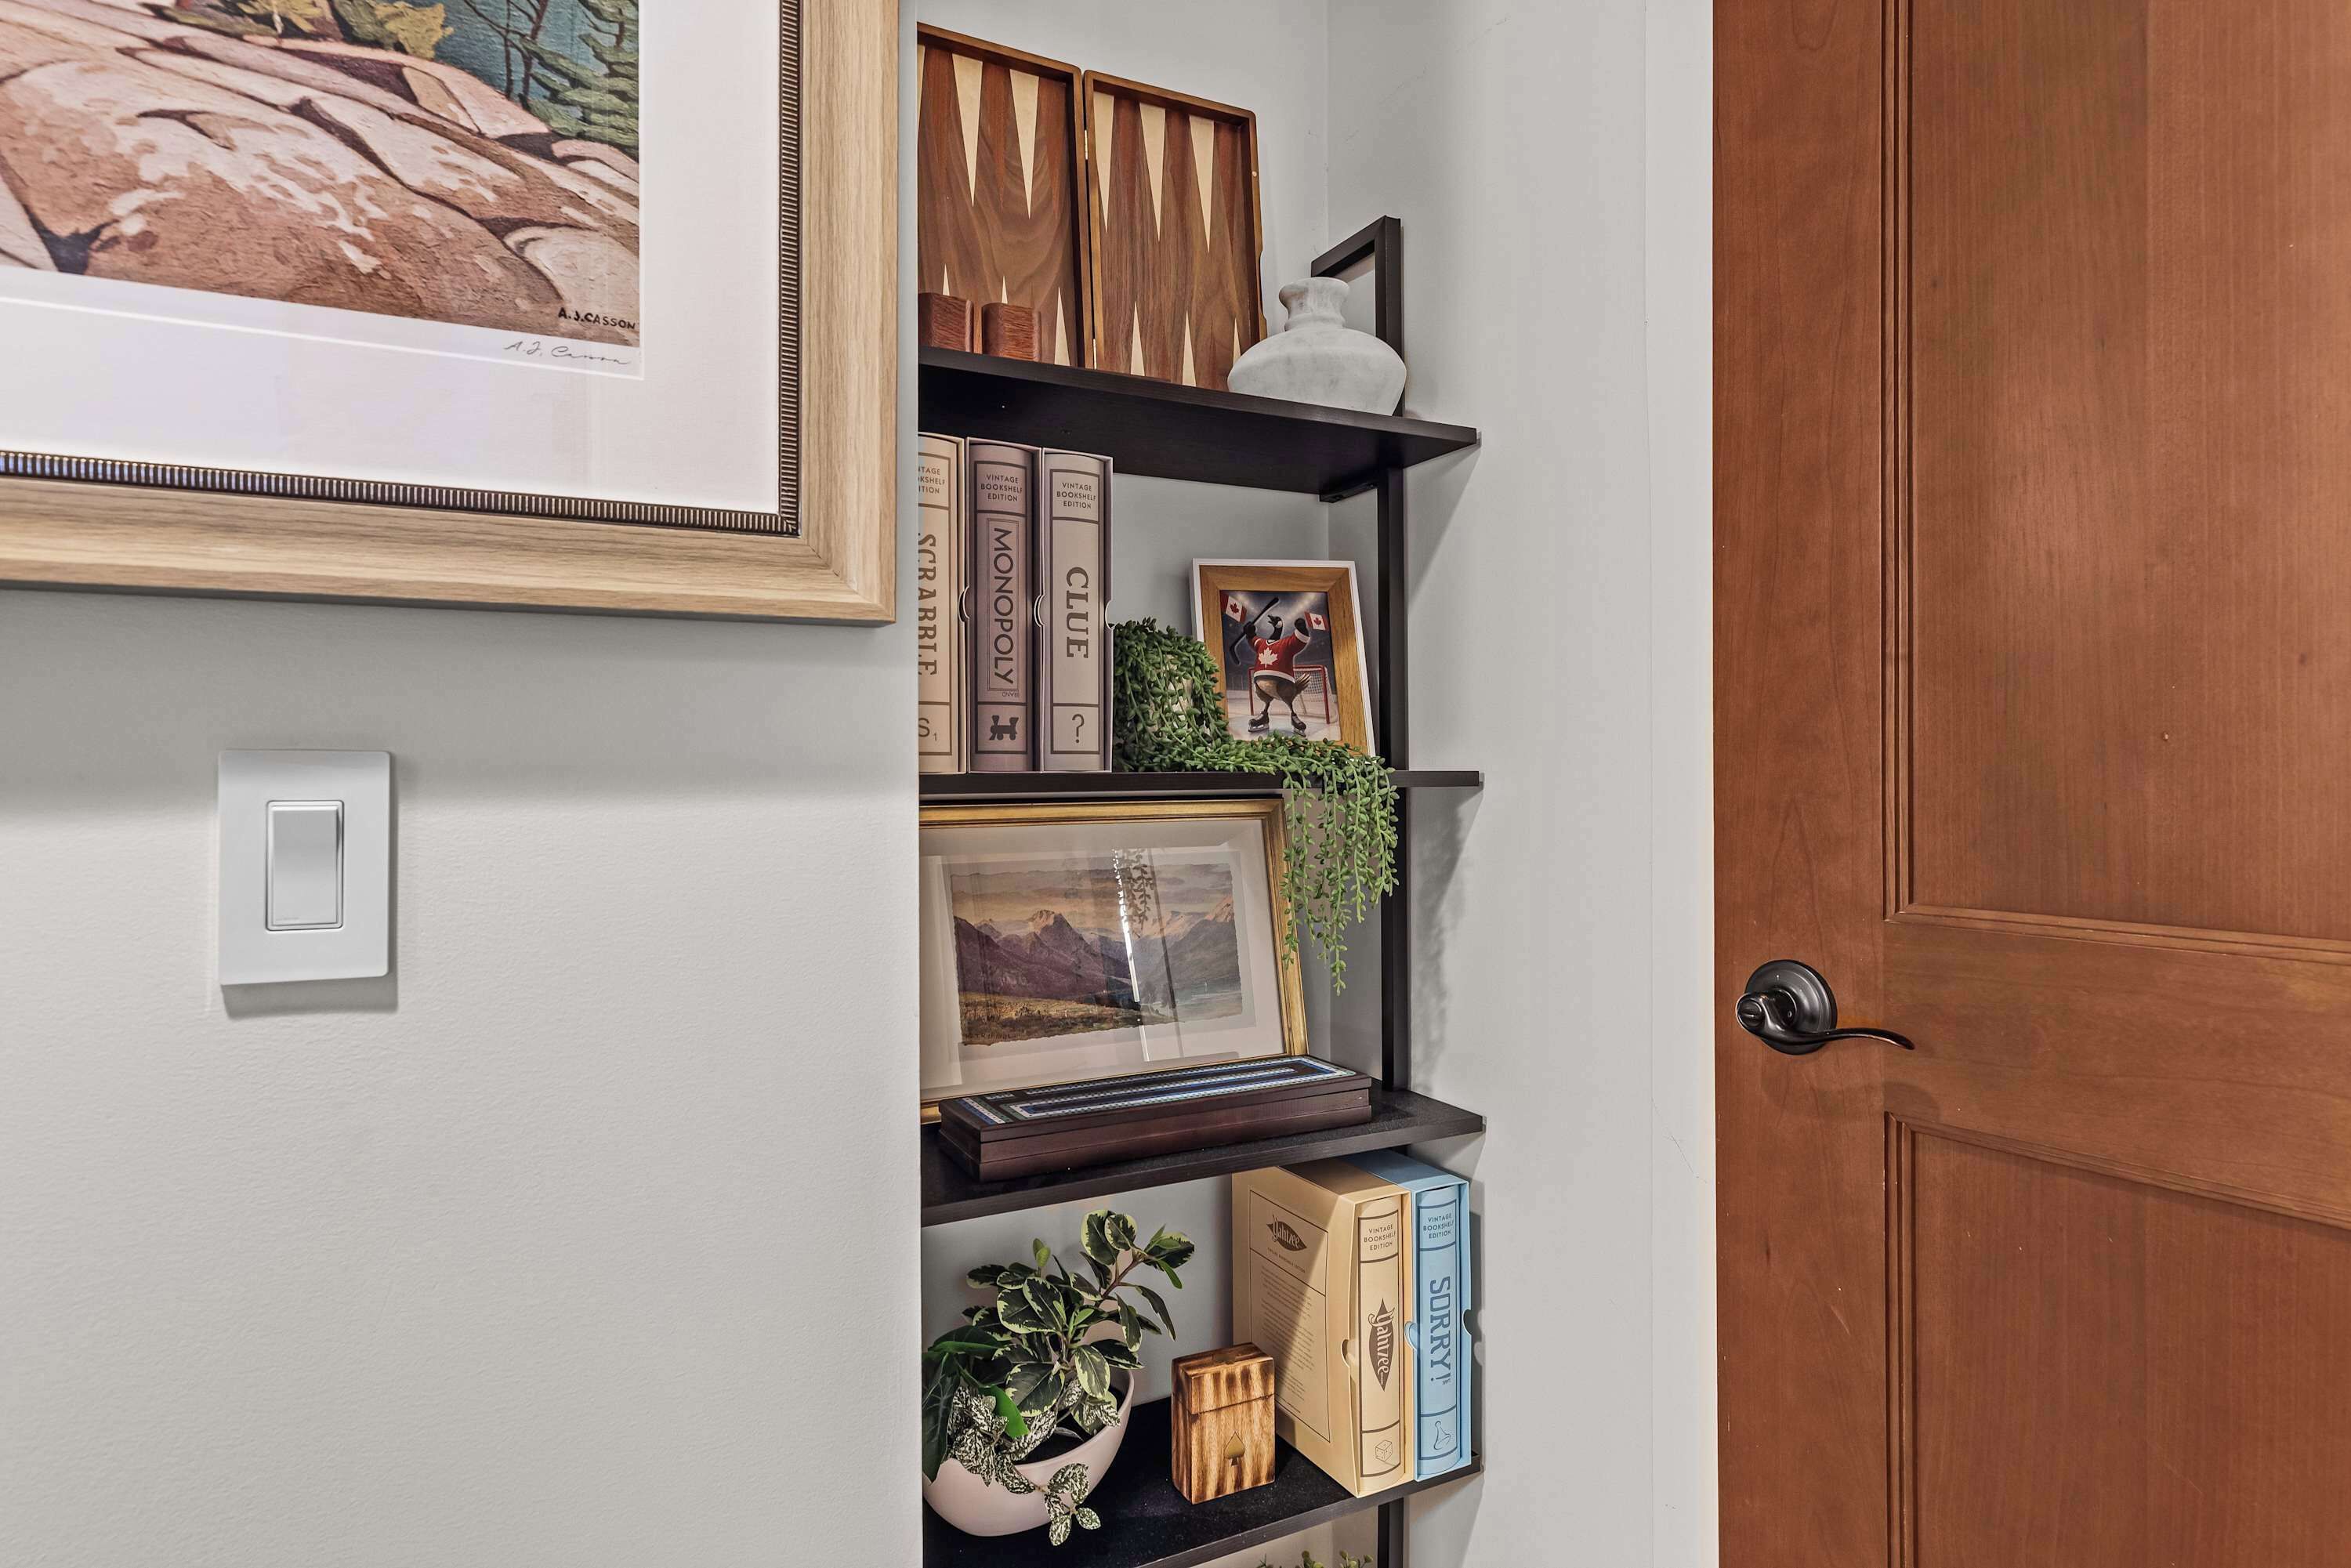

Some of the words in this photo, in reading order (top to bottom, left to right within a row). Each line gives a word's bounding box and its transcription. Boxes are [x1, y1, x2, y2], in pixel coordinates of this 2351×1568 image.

[918, 465, 940, 475] TAGE
[918, 476, 946, 485] KSHELF
[987, 474, 1019, 483] VINTAGE
[918, 485, 940, 494] ITION
[980, 483, 1023, 494] BOOKSHELF
[1062, 482, 1092, 491] VINTAGE
[987, 493, 1018, 502] EDITION
[1056, 491, 1096, 502] BOOKSHELF
[1063, 501, 1092, 509] EDITION
[994, 527, 1014, 684] MONOPOLY
[1066, 567, 1089, 658] CLUE
[1428, 1213, 1451, 1222] VINTAGE
[1368, 1223, 1393, 1233] VINTAGE
[1423, 1219, 1454, 1231] BOOKSHELF
[1272, 1214, 1300, 1250] Yahtzee
[1364, 1230, 1396, 1243] BOOKSHELF
[1429, 1229, 1451, 1239] EDITION
[1369, 1241, 1393, 1251] EDITION
[1429, 1276, 1451, 1382] SORRY!
[1367, 1307, 1395, 1375] Yahtzee
